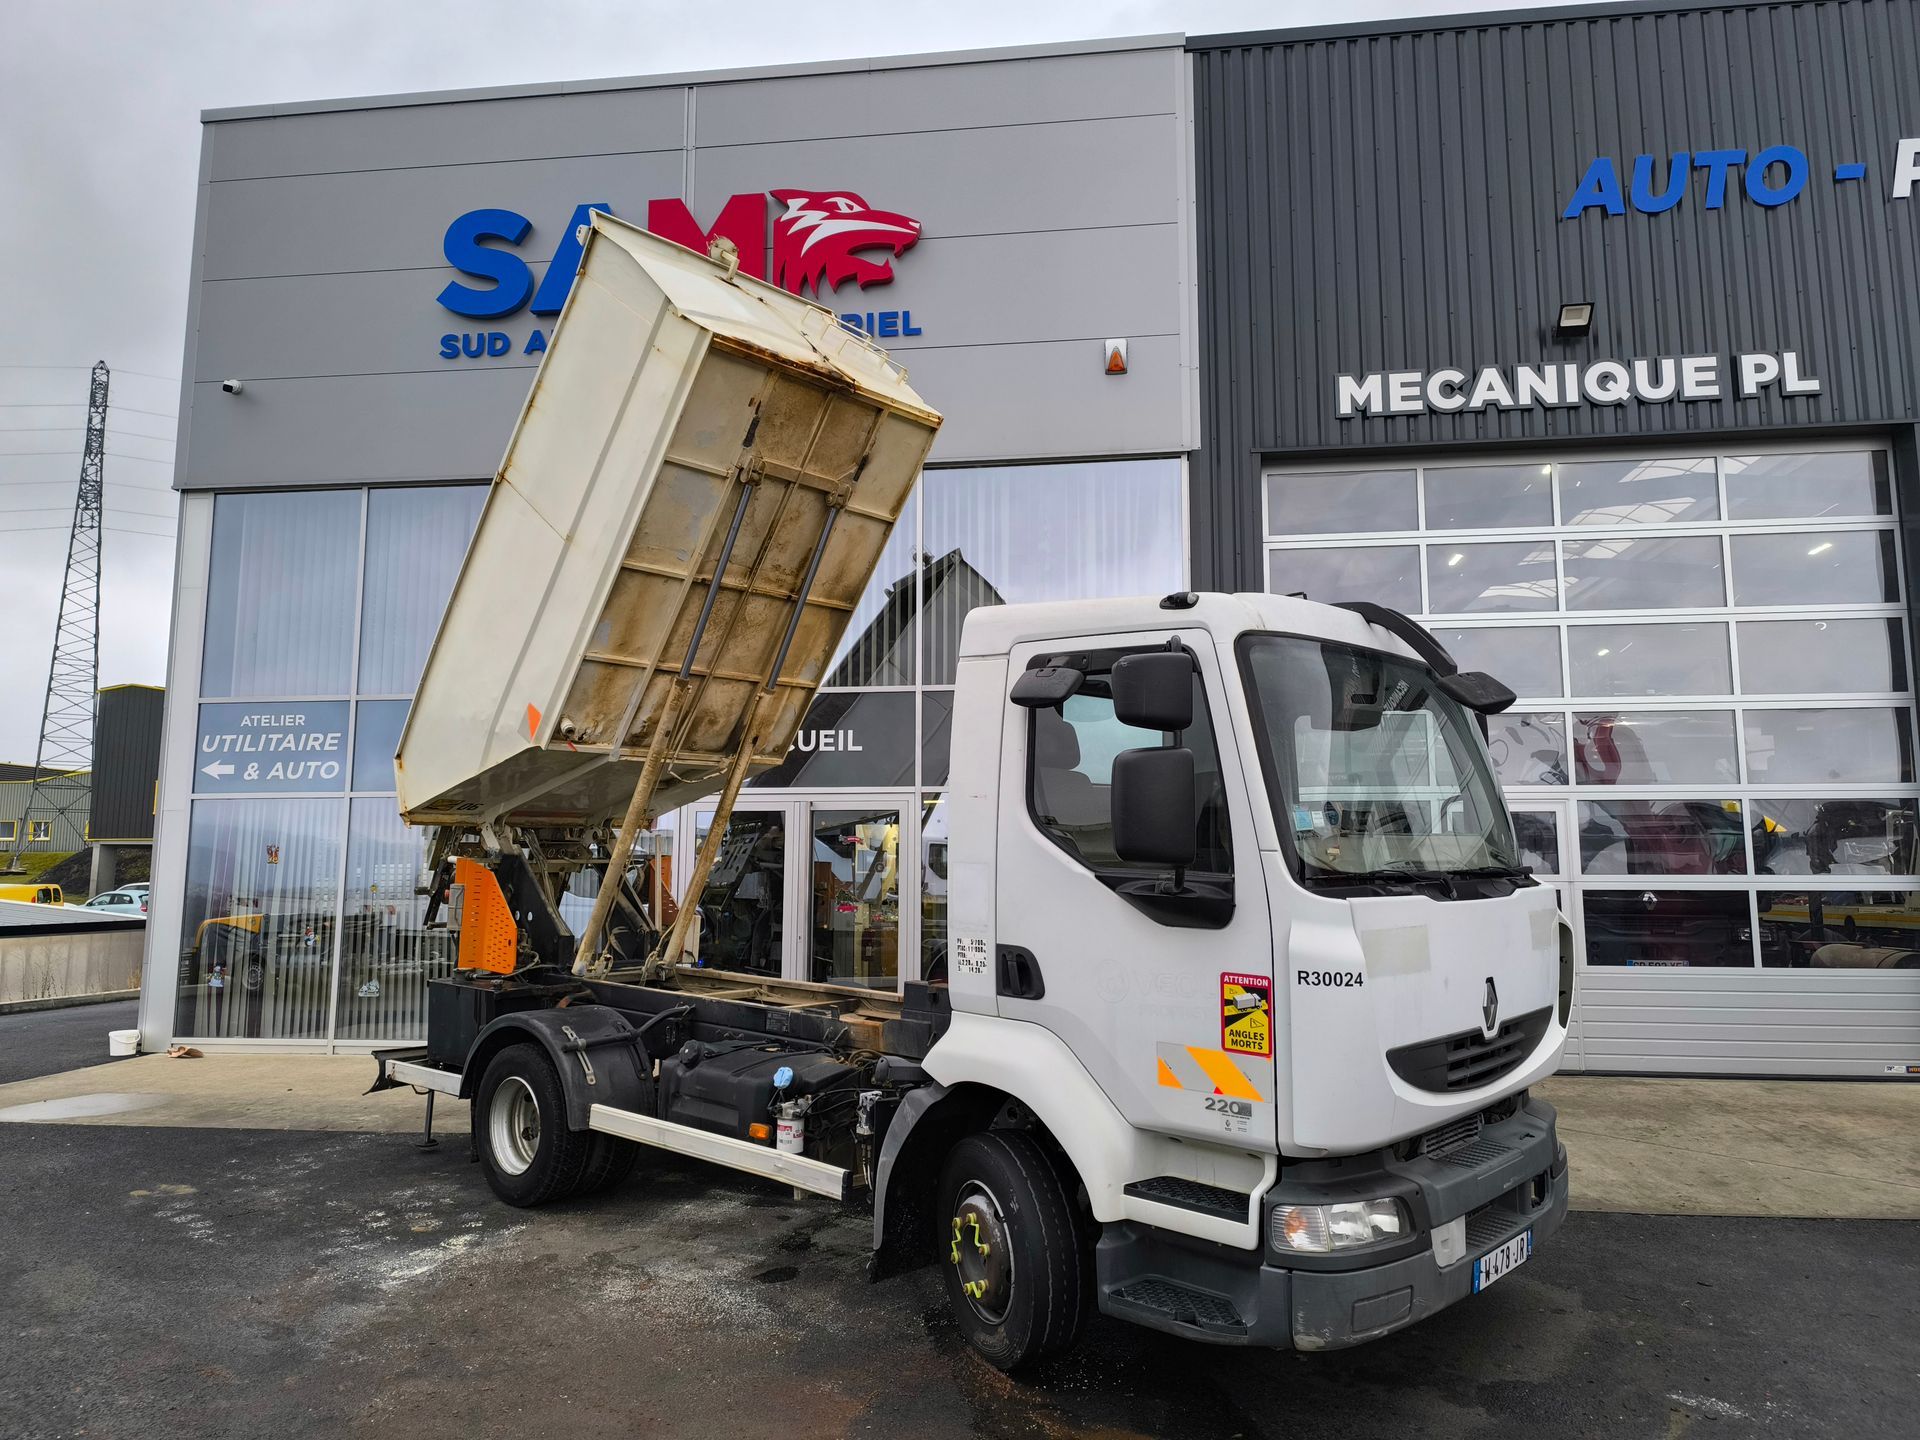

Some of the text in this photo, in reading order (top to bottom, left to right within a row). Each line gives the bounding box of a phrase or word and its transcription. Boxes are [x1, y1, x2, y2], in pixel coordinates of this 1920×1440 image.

[1562, 145, 1809, 218] AUTO
[439, 331, 511, 359] SUD
[1337, 351, 1821, 416] MECANIQUE PL
[240, 714, 306, 727] ATELIER
[202, 732, 341, 752] UTILITAIRE
[788, 729, 863, 752] UEIL
[243, 760, 340, 780] & AUTO
[1223, 975, 1268, 987] ATTENTION
[1297, 970, 1363, 987] R30024
[1228, 1029, 1265, 1041] ANGLES
[1231, 1038, 1263, 1050] MORTS
[1204, 1097, 1241, 1115] 220
